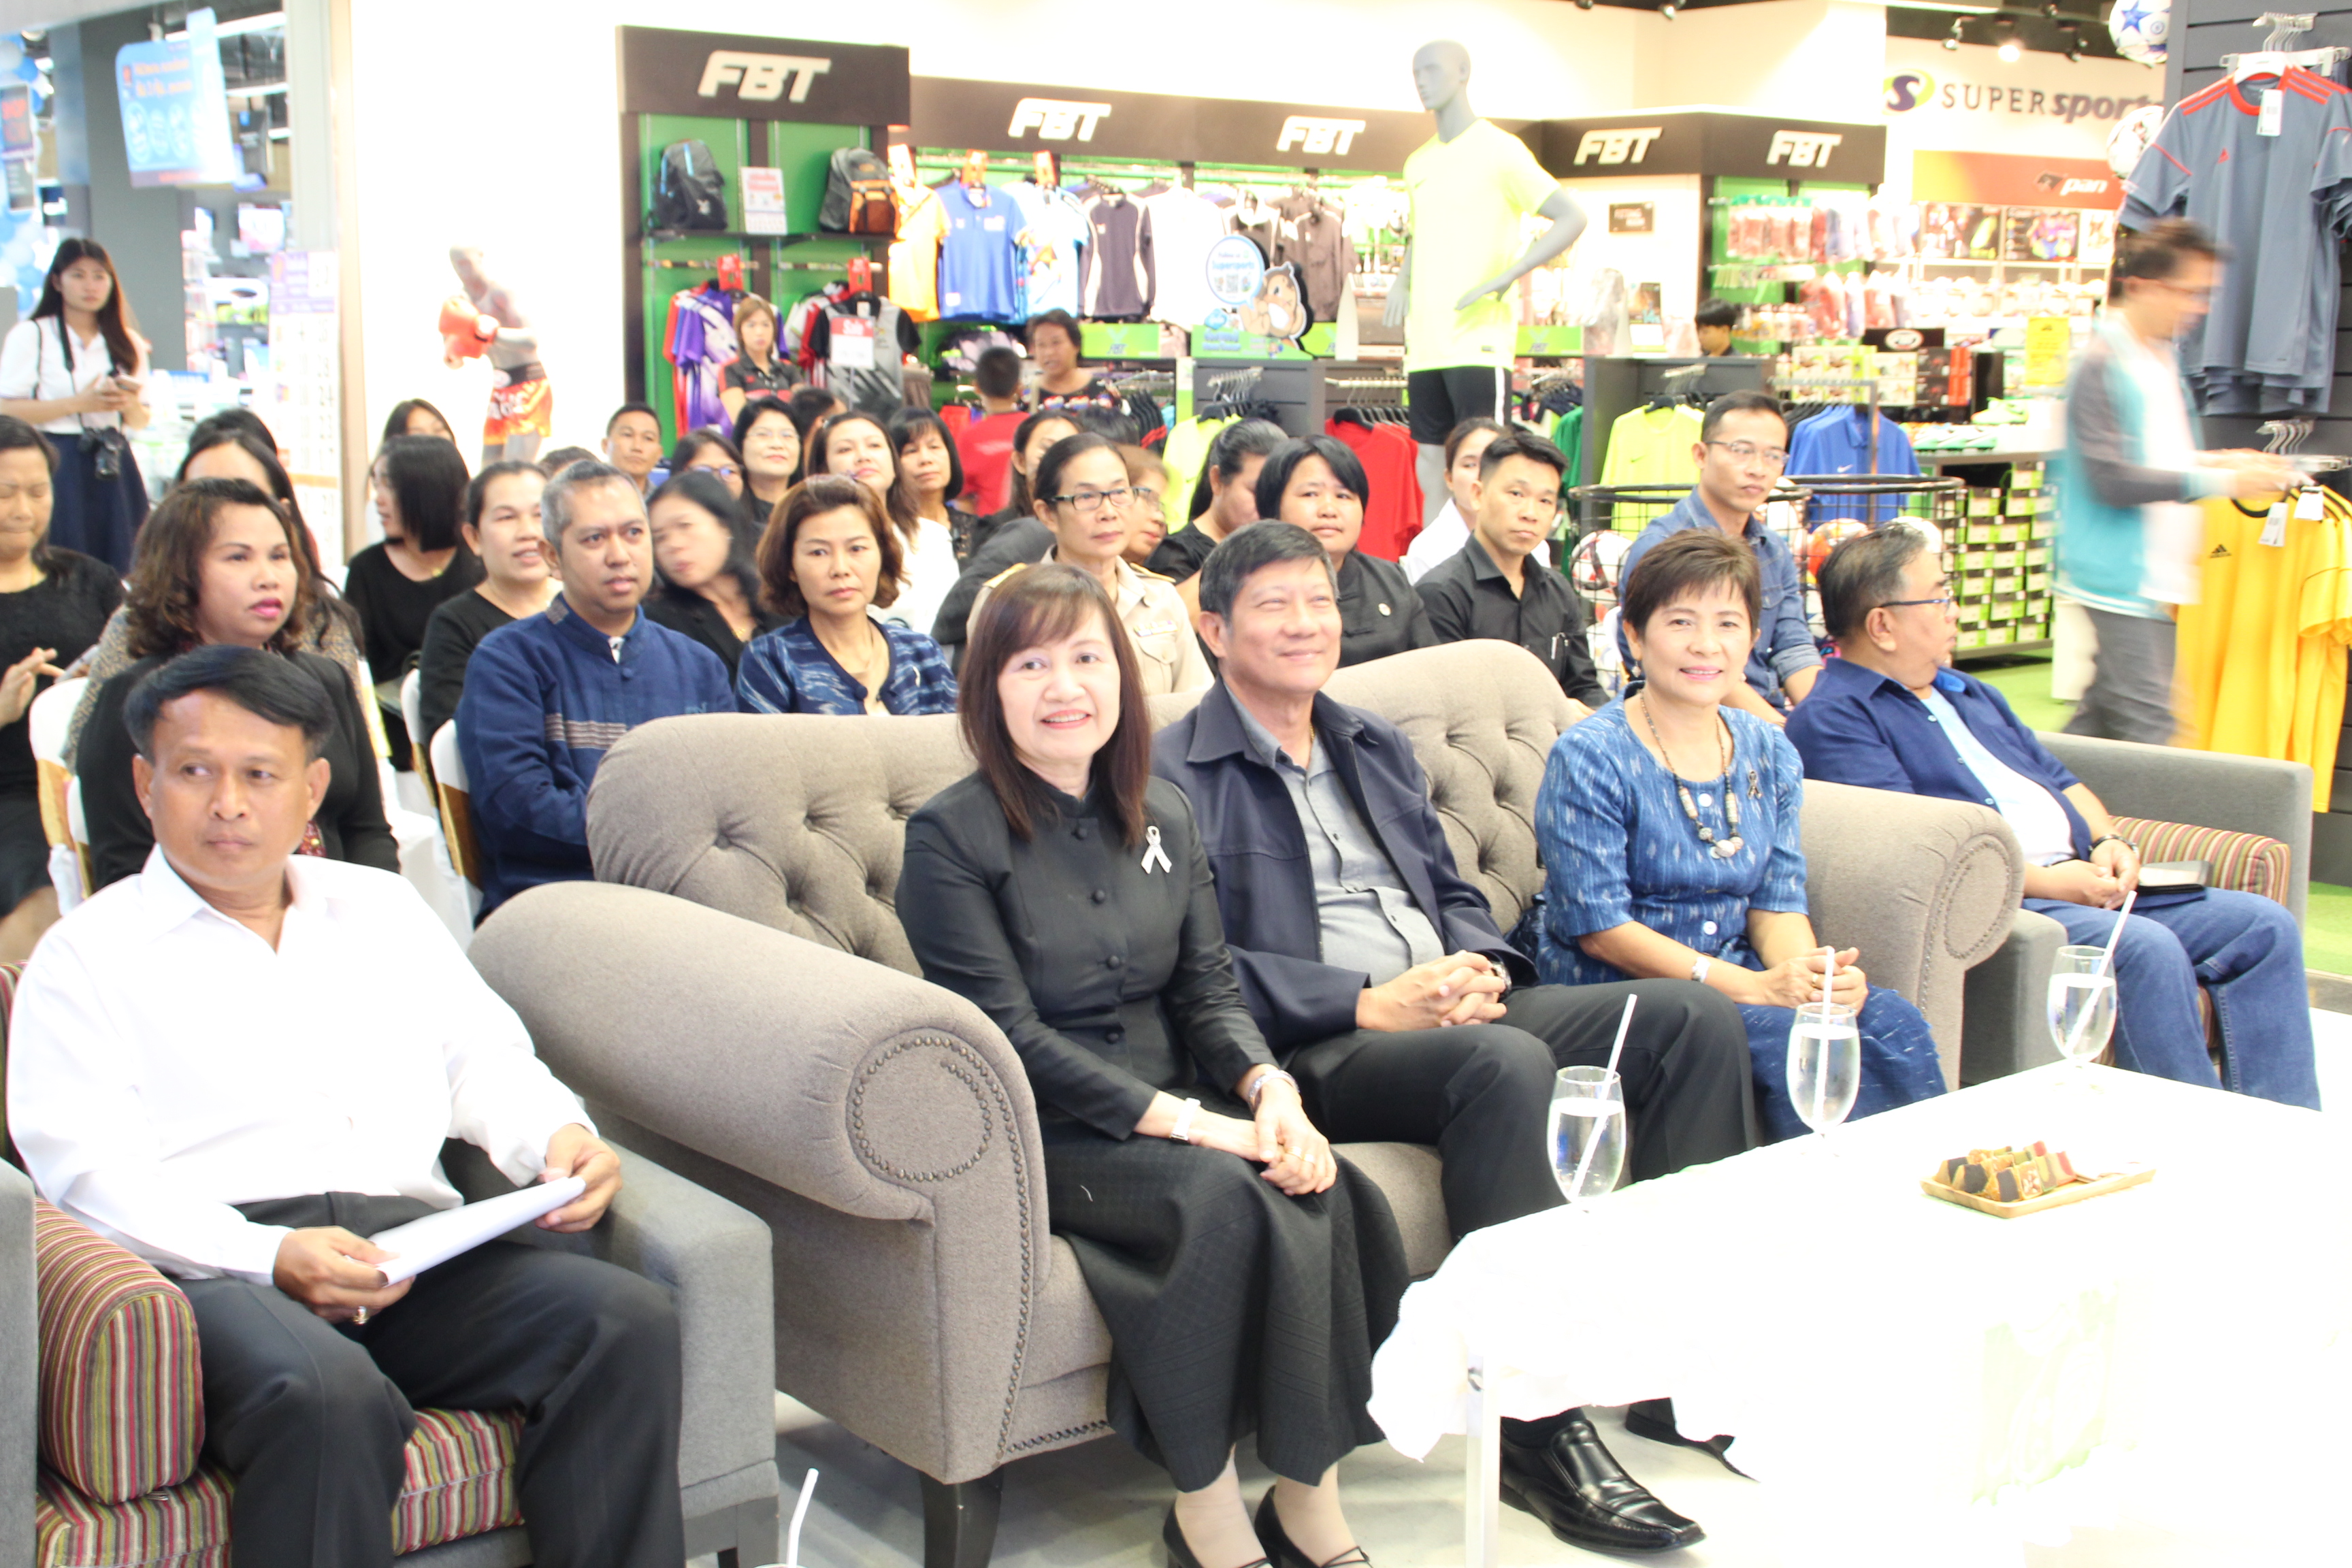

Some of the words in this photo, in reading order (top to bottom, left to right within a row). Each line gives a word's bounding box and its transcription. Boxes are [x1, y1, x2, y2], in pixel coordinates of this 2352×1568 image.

[698, 49, 832, 103] FBT
[1007, 97, 1112, 142] FBT
[1942, 82, 2163, 123] SUPERsport
[1275, 114, 1367, 156] FBT
[1573, 126, 1663, 166] FBT
[1766, 129, 1844, 168] FBT
[2059, 177, 2109, 197] pan
